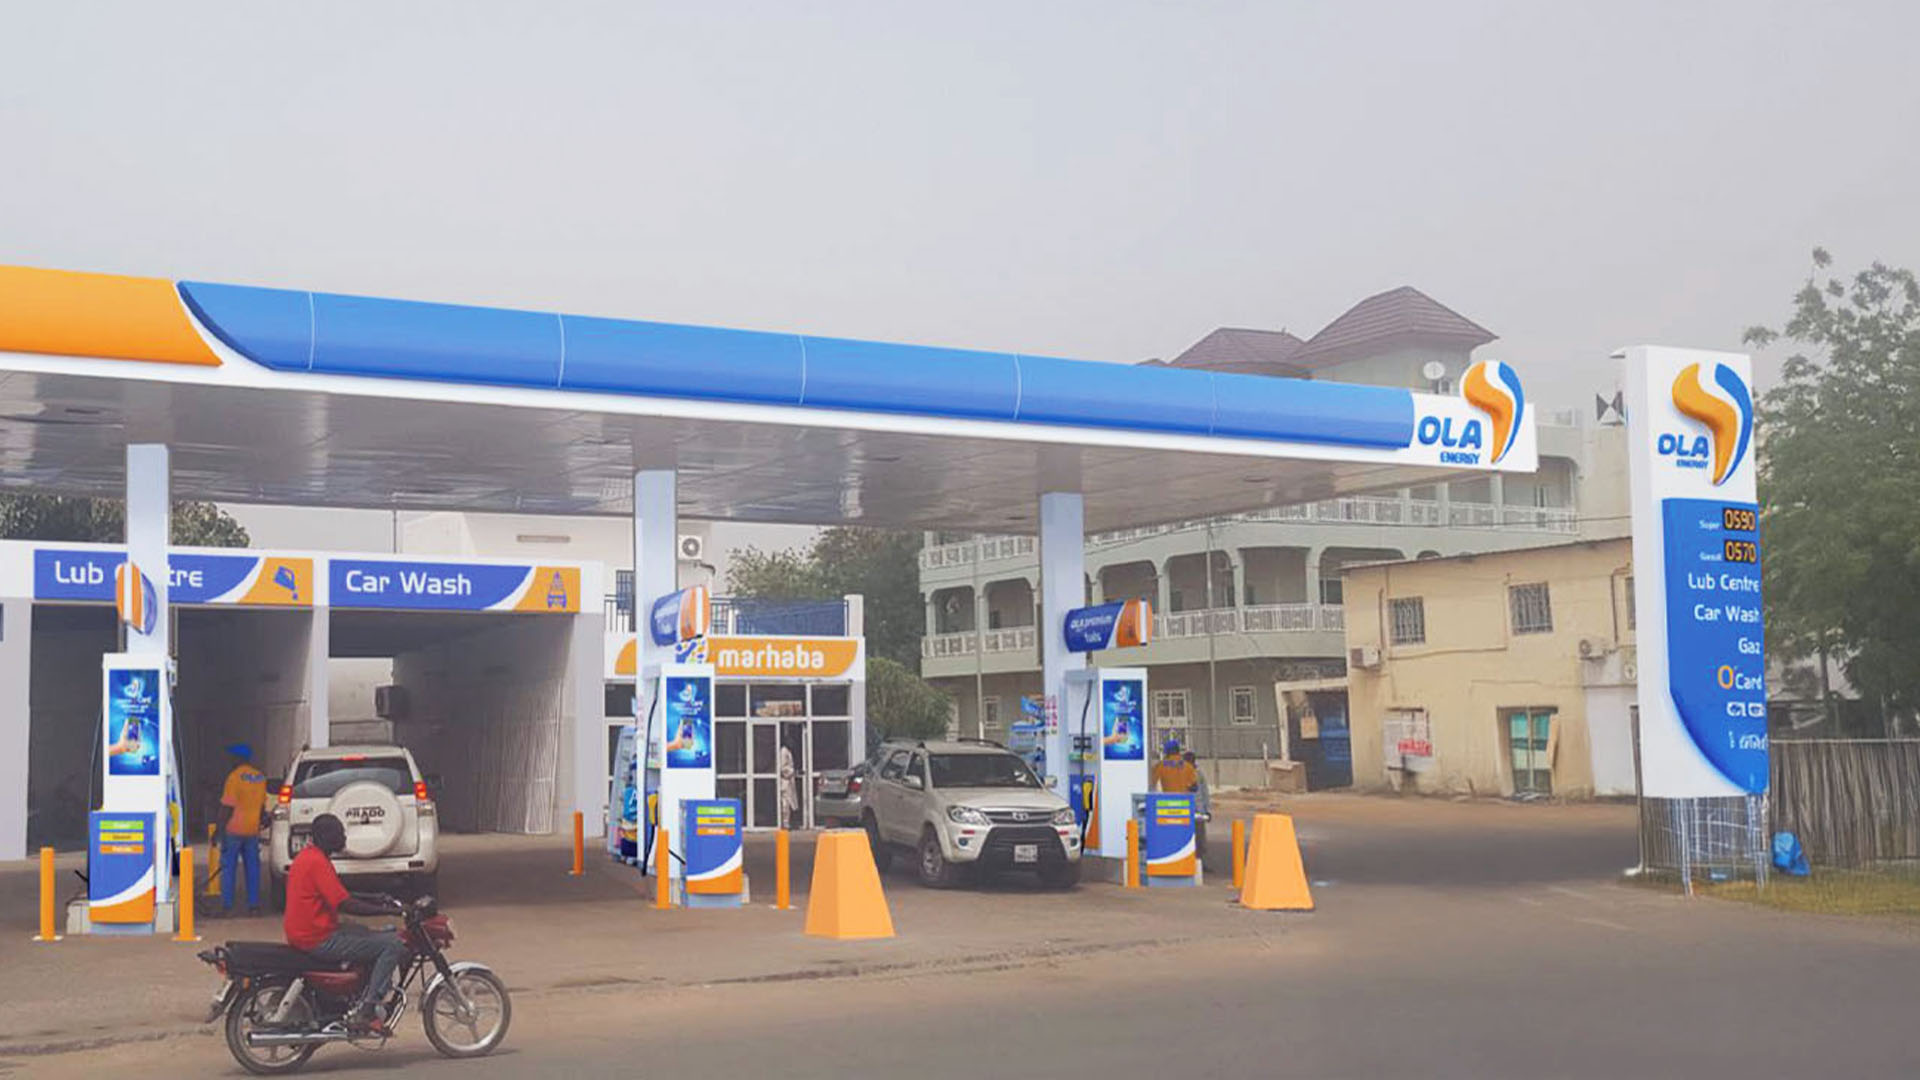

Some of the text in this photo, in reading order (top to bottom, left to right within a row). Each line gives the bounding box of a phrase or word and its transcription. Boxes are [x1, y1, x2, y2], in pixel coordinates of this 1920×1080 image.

[1418, 416, 1481, 448] OLA
[1658, 433, 1709, 458] OLA
[1440, 452, 1480, 464] ENERGY
[1724, 508, 1755, 531] 0590
[1725, 541, 1756, 563] 0570
[55, 560, 104, 585] Lub
[346, 570, 471, 596] Car Wash
[1688, 572, 1760, 593] Lub Centre
[1694, 604, 1720, 620] Car
[1738, 637, 1761, 654] Gaz
[717, 645, 824, 669] marhaba
[345, 808, 386, 819] PRADO
